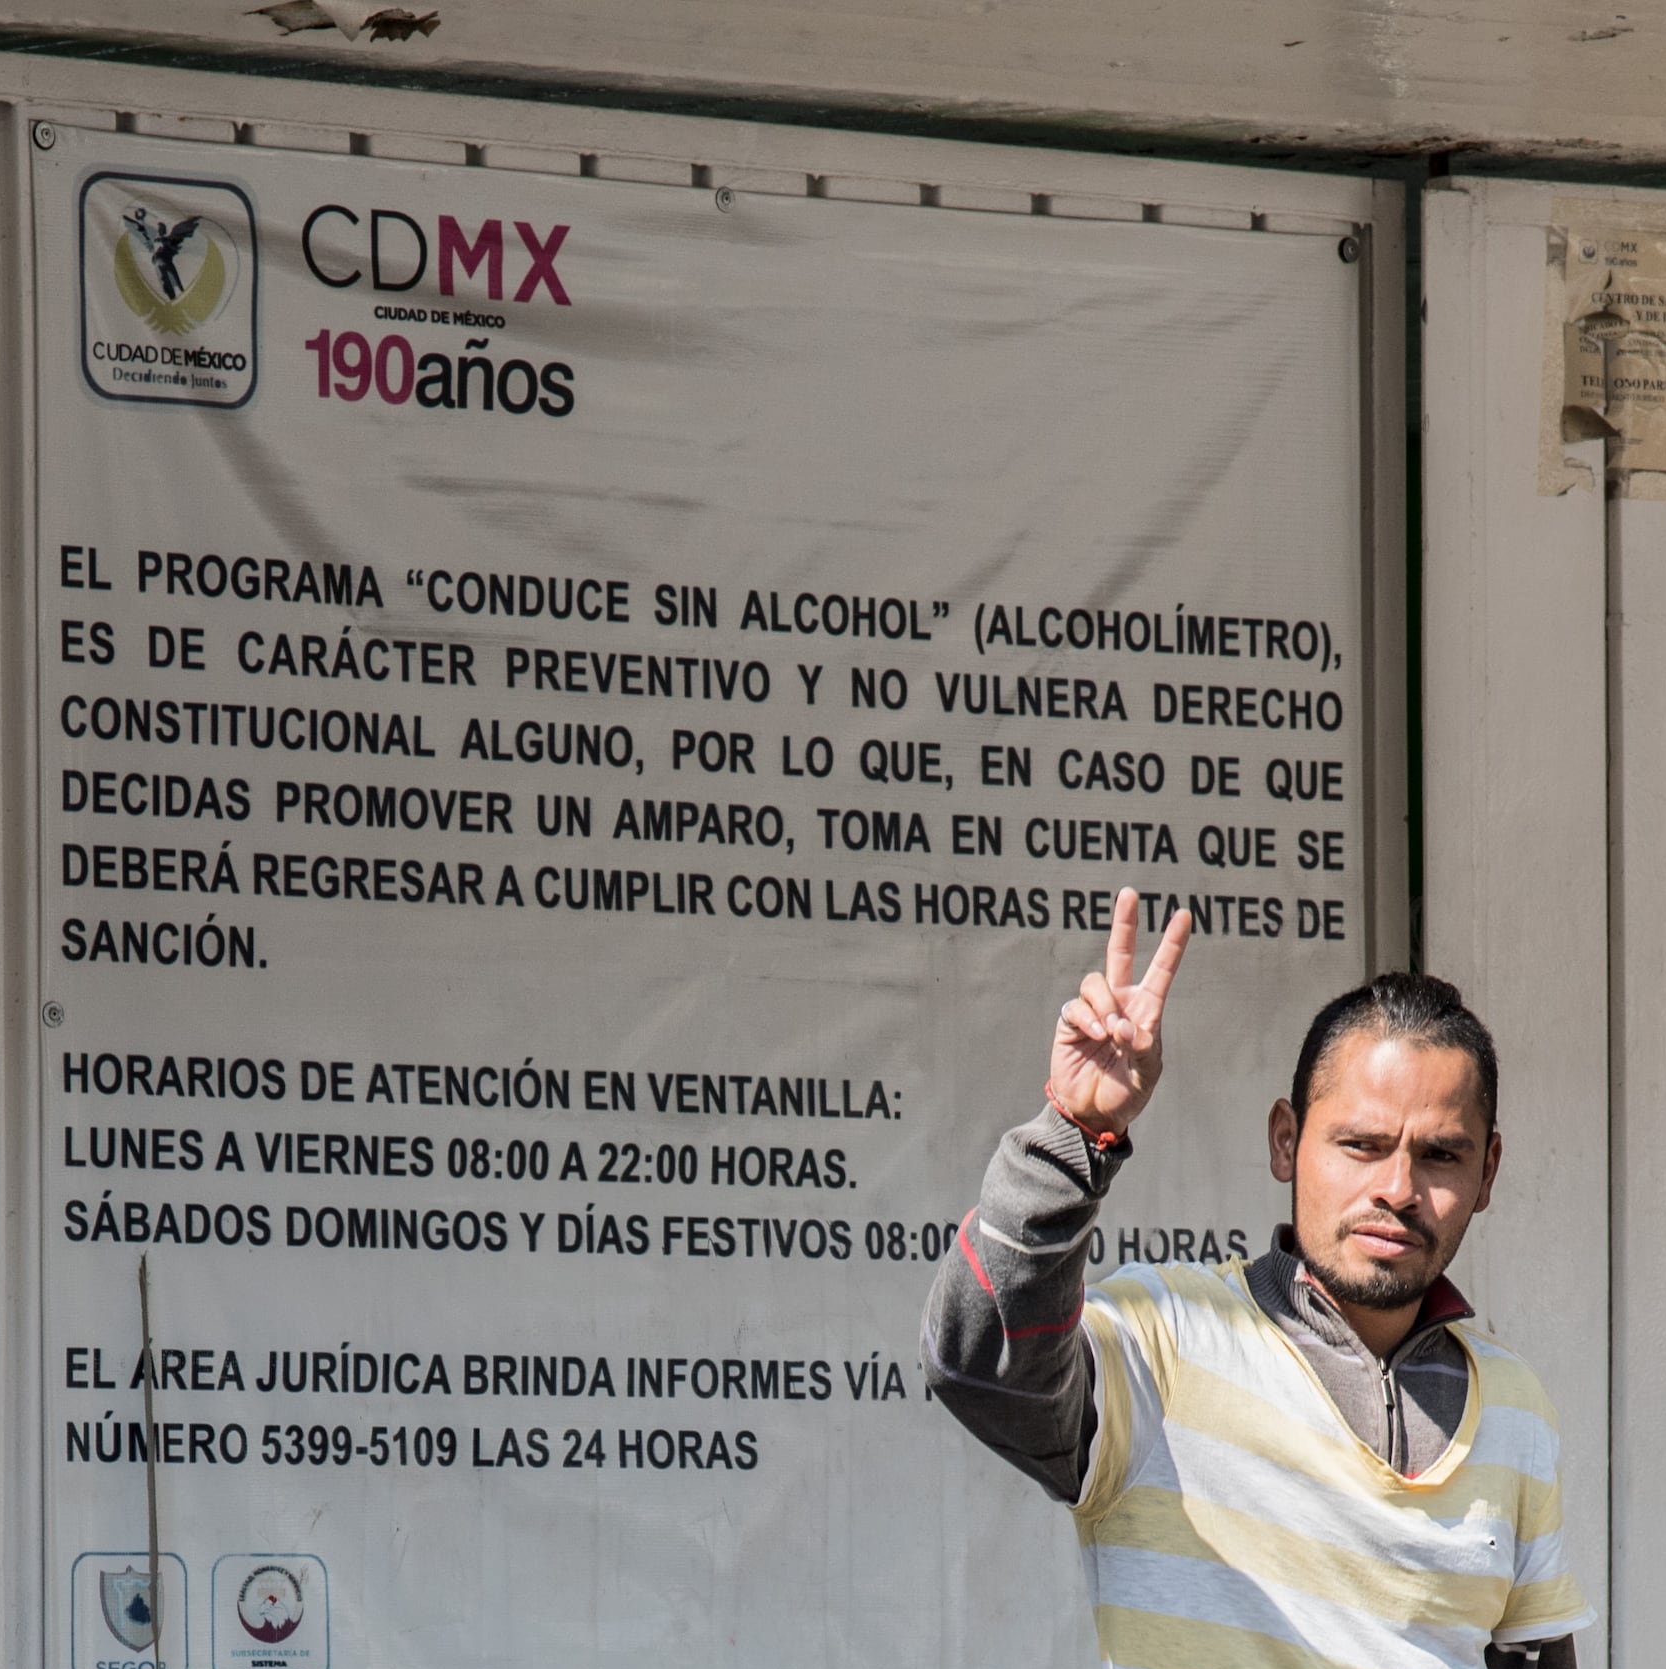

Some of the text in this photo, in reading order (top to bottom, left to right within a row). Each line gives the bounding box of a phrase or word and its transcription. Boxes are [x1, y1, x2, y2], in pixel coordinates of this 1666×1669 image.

[301, 204, 572, 307] CDMX
[374, 306, 505, 329] CIUDAD DE MÉXICO
[1591, 292, 1639, 306] CENTRO
[1641, 294, 1656, 307] DE
[1634, 310, 1644, 321] Y
[1645, 311, 1661, 323] DE
[185, 347, 246, 371] MÉXICO
[305, 328, 574, 417] 190años
[61, 545, 1341, 672] EL PROGRAMA “CONDUCE SIN ALCOHOL” (ALCOHOLÍMETRO),
[61, 620, 1342, 731] ES DE CARÁCTER PREVENTIVO Y NO VULNERA DERECHO
[61, 695, 1343, 802] CONSTITUCIONAL ALGUNO, POR LO QUE, EN CASO DE QUE
[63, 770, 1344, 870] DECIDAS PROMOVER UN AMPARO, TOMA EN CUENTA QUE SE
[63, 840, 1345, 940] DEBERÁ REGRESAR A CUMPLIR CON LAS HORAS RETANTES DE
[62, 913, 267, 968] SANCIÓN.
[64, 1052, 901, 1119] HORARIOS DE ATENCIÓN EN VENTANILLA:
[65, 1127, 856, 1189] LUNES A VIERNES 08:00 A 22:00 HORAS.
[65, 1190, 271, 1246] SÁBADOS
[287, 1207, 507, 1251] DOMINGOS
[520, 1213, 545, 1252] Y
[558, 1203, 649, 1255] DÍAS
[662, 1216, 852, 1259] FESTIVOS
[1118, 1227, 1248, 1264] HORAS
[67, 1348, 116, 1389] EL
[130, 1337, 245, 1392] ÁREA
[256, 1342, 451, 1394] JURÍDICA
[464, 1355, 615, 1397] BRINDA
[628, 1358, 831, 1400] INFORMES
[844, 1352, 906, 1400] VÍA
[65, 1410, 758, 1470] NÚMERO 5399-5109 LAS 24 HORAS
